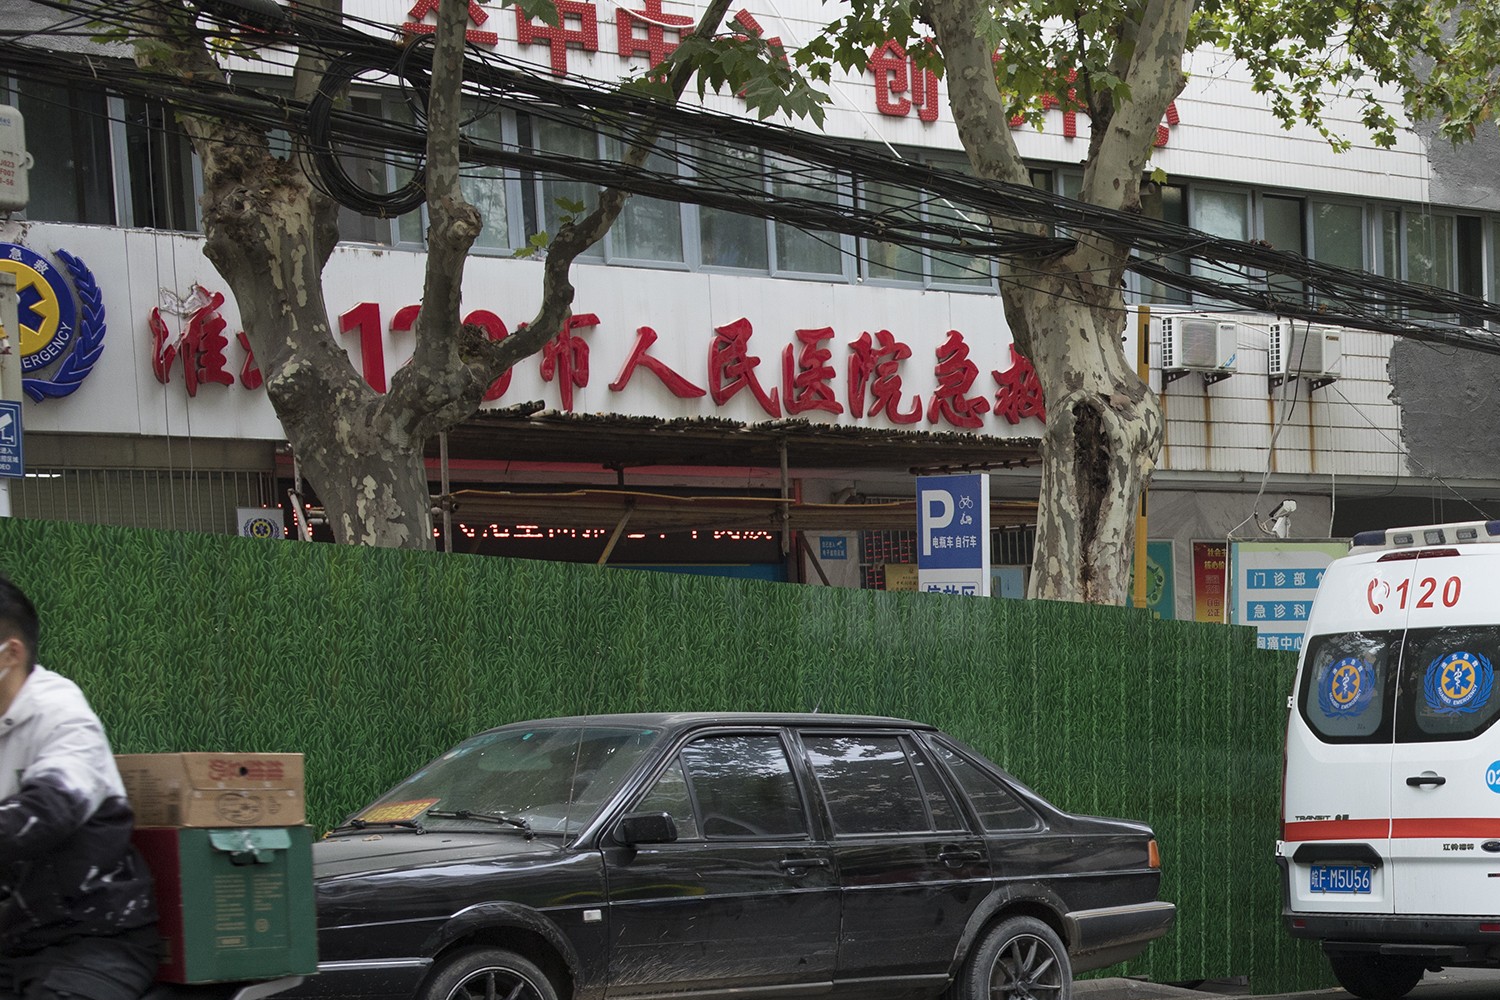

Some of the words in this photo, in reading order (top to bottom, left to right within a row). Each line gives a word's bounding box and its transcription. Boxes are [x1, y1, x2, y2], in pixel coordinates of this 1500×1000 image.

[21, 321, 73, 370] ERGENCY
[921, 489, 955, 556] P
[932, 536, 954, 549] 电瓶车
[955, 535, 977, 548] 自行车
[1253, 571, 1306, 587] 门诊部
[1395, 574, 1462, 610] 120
[1253, 603, 1307, 619] 急诊科
